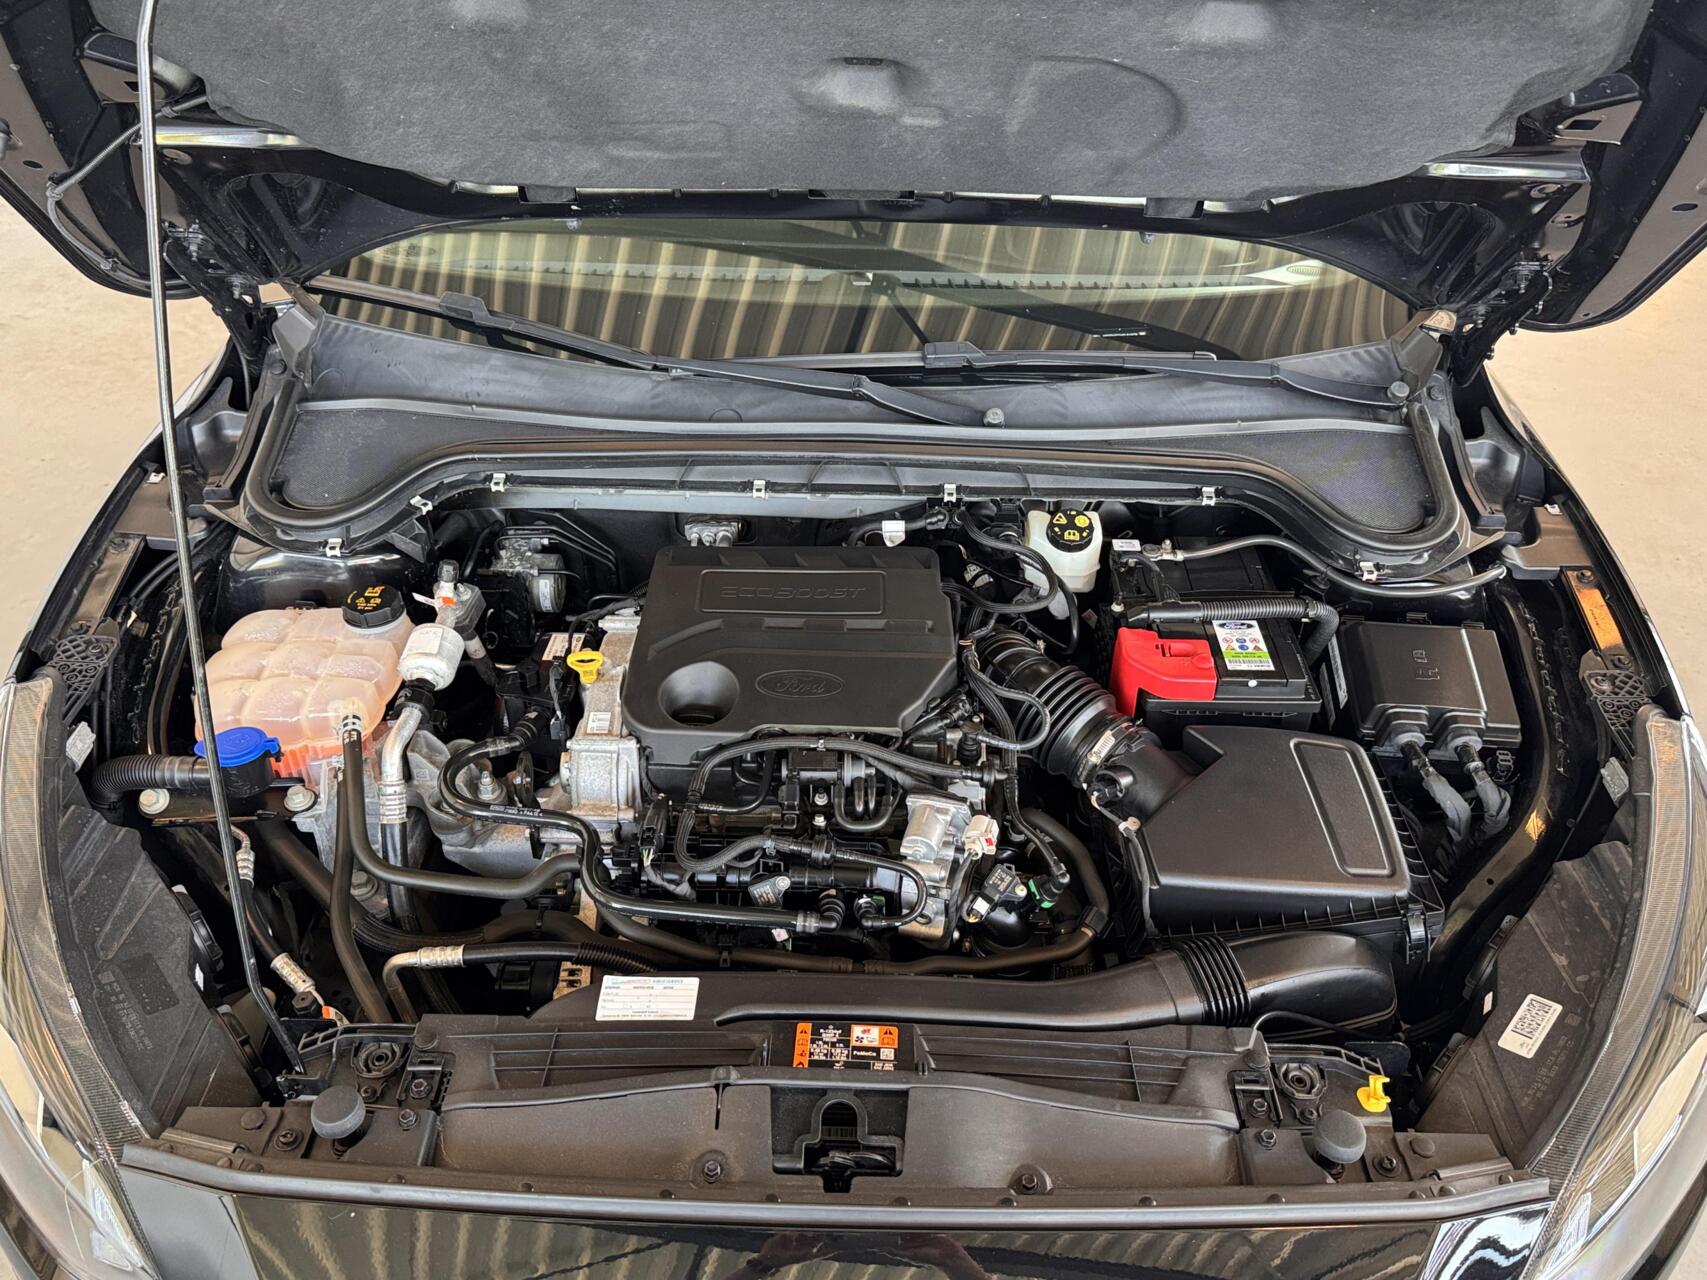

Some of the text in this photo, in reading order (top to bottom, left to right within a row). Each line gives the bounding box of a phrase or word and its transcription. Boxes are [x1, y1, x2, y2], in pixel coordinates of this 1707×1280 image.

[720, 586, 865, 599] ECOBOOST
[1223, 621, 1248, 629] Ford
[775, 677, 826, 693] Ford
